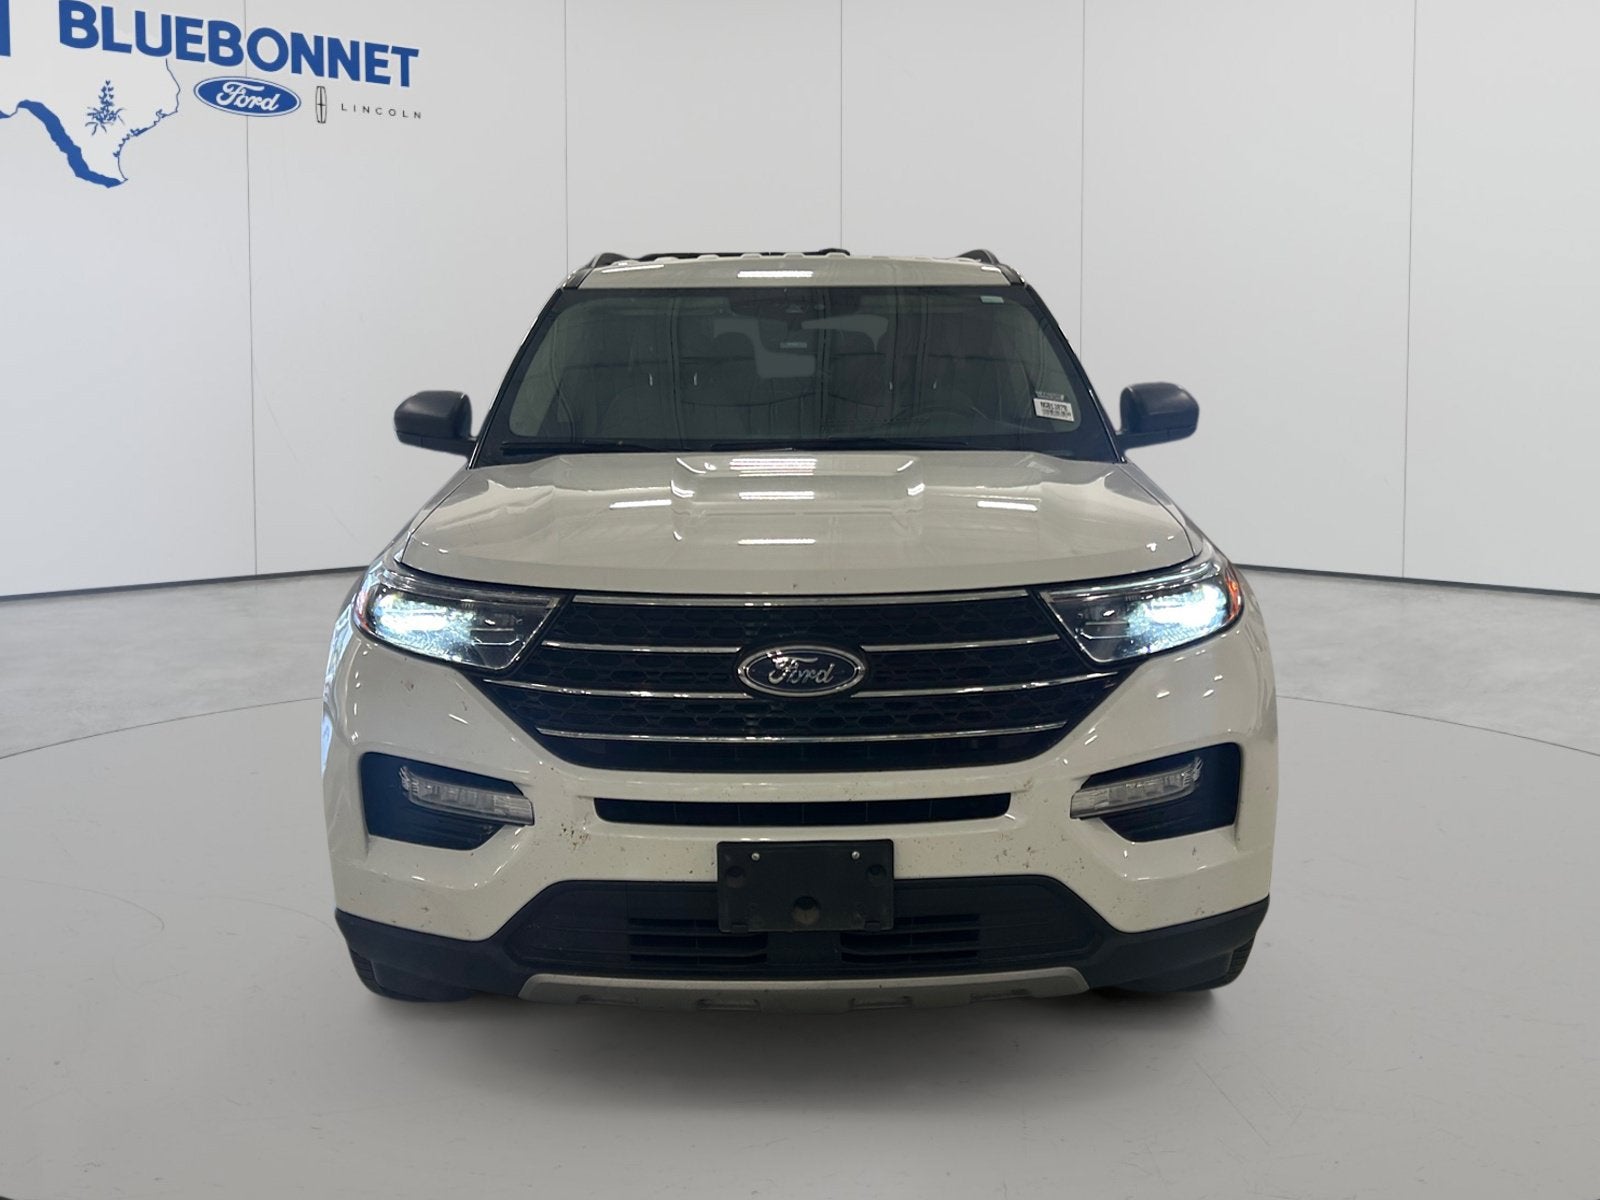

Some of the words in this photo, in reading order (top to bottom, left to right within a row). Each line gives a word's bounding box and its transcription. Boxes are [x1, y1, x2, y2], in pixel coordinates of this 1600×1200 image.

[59, 0, 420, 88] BLUEBONNET
[215, 81, 281, 113] Ford
[340, 103, 422, 119] LINCOLN
[768, 655, 835, 685] Ford
